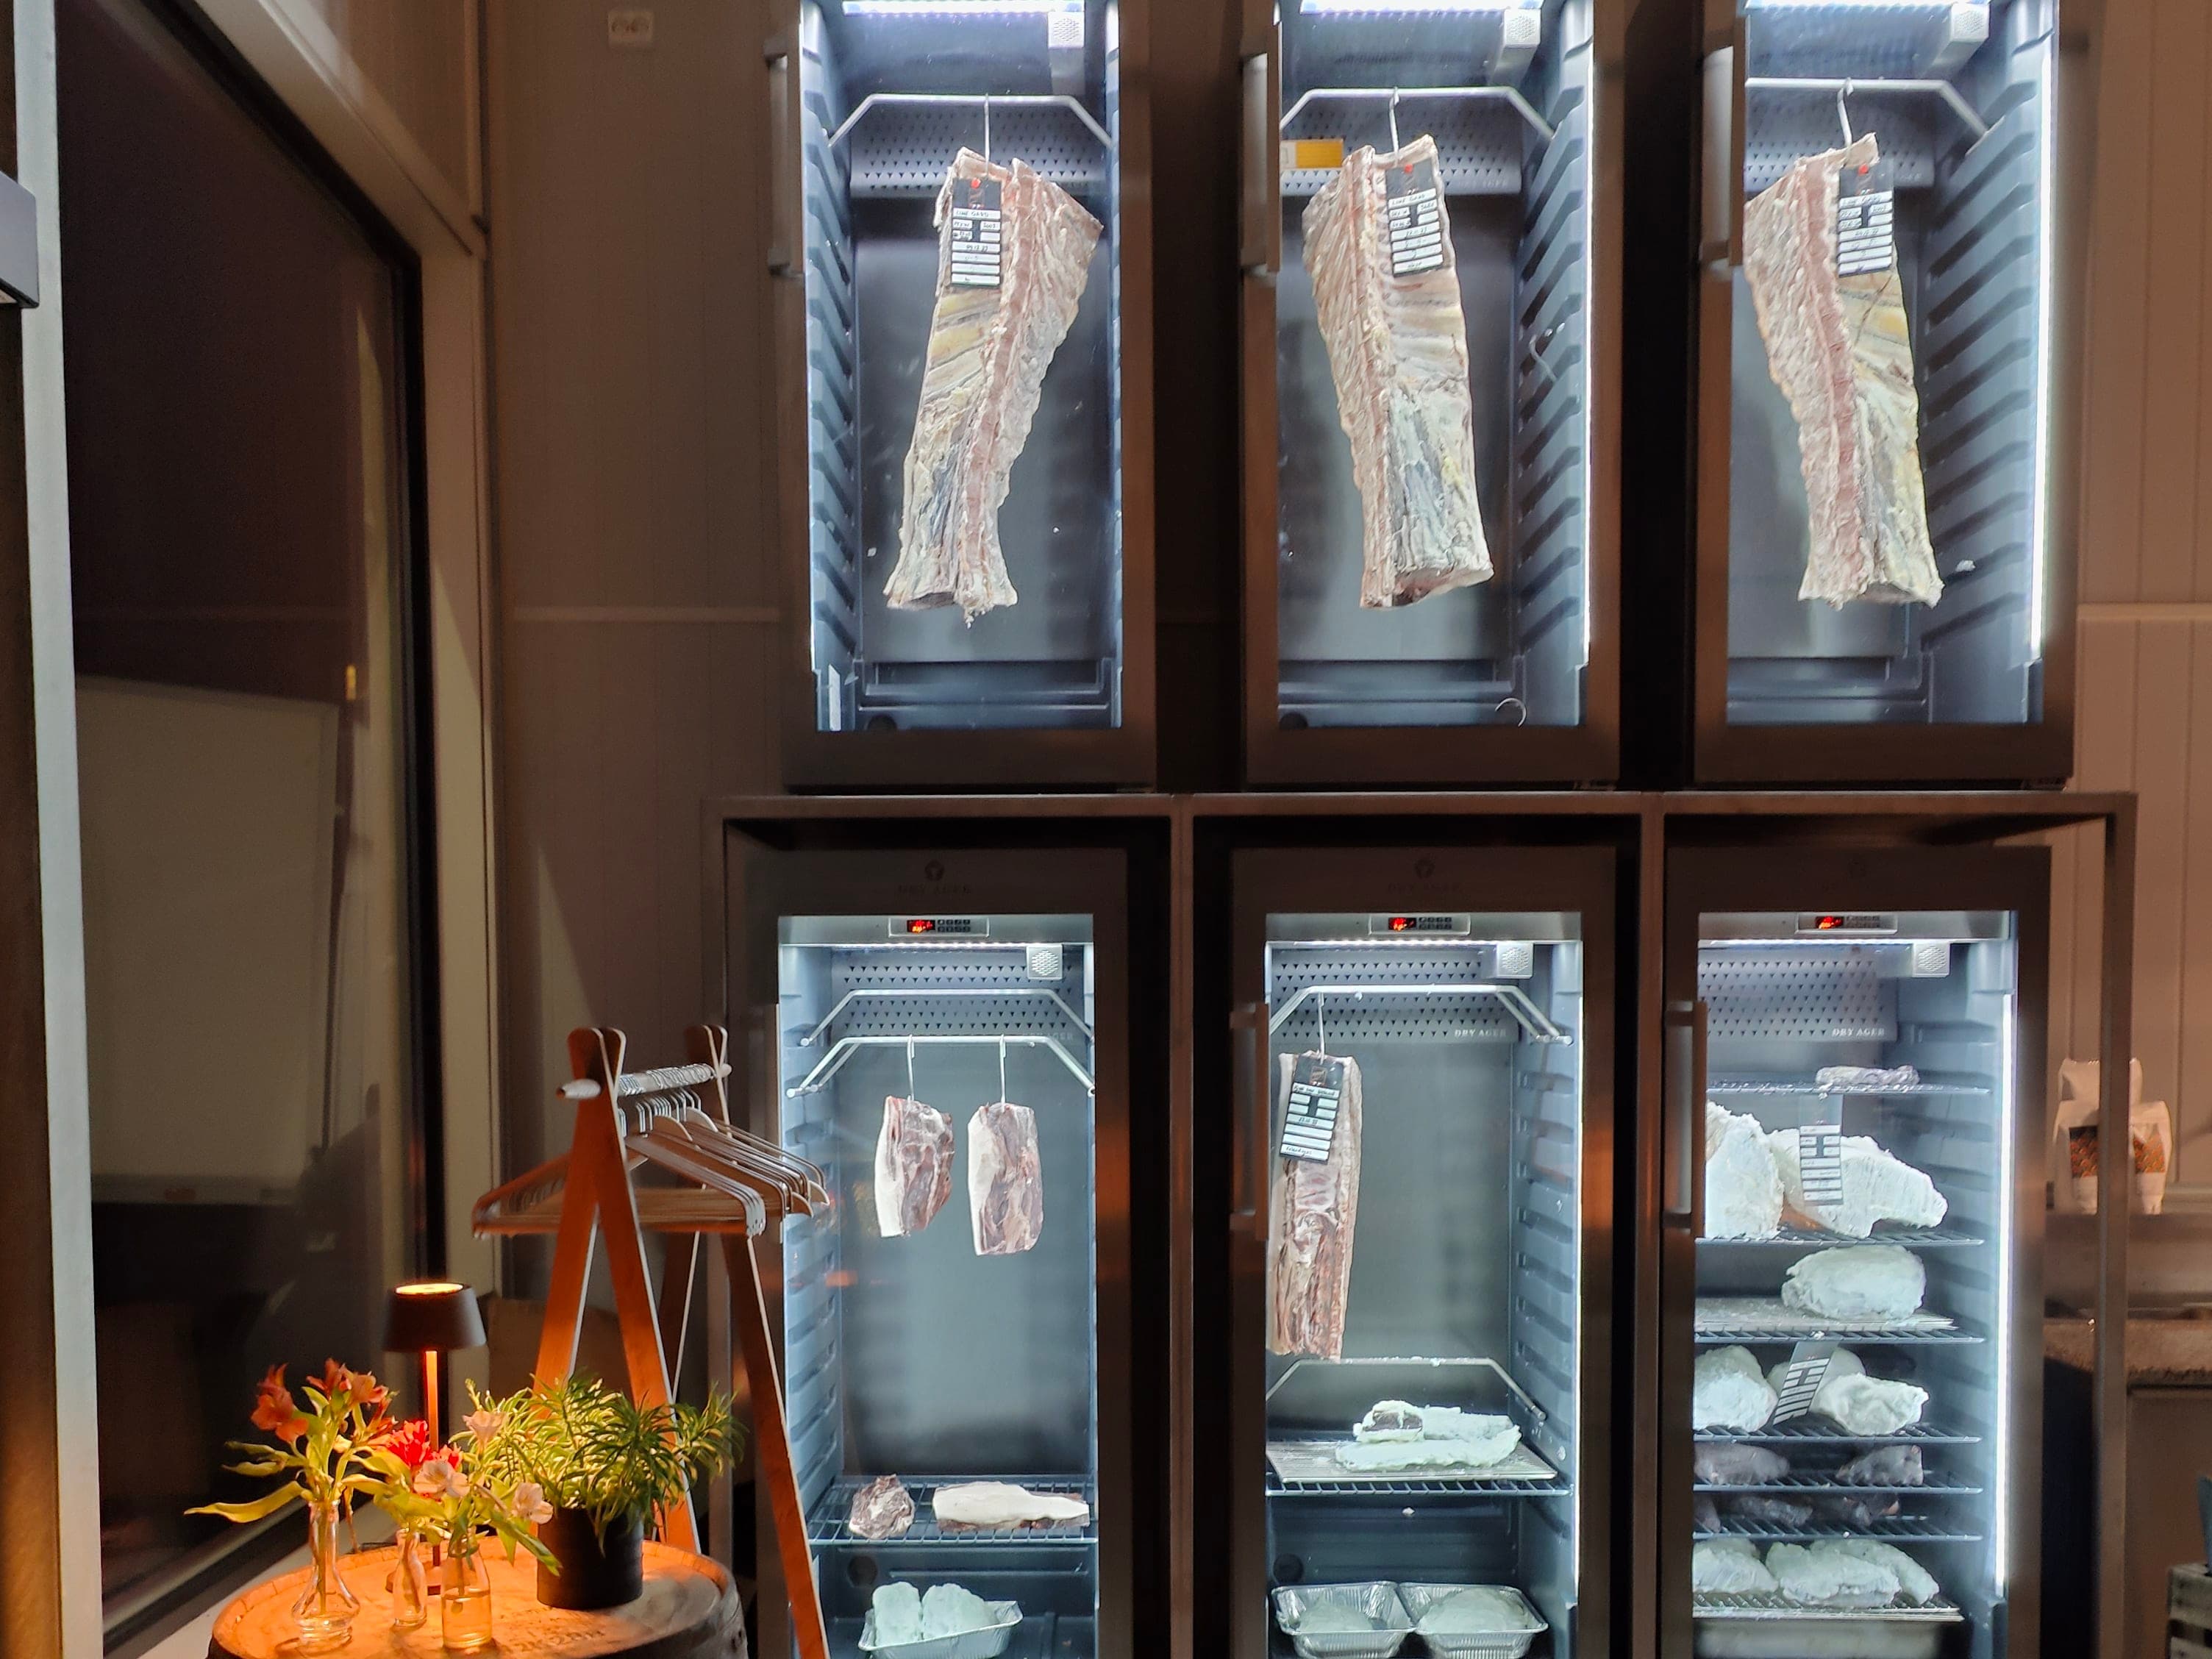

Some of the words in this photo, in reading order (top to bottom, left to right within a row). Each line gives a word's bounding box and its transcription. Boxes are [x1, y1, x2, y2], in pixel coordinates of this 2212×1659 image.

[1455, 1029, 1476, 1038] DRY
[1832, 1028, 1854, 1037] DRY
[1856, 1028, 1885, 1037] AGER
